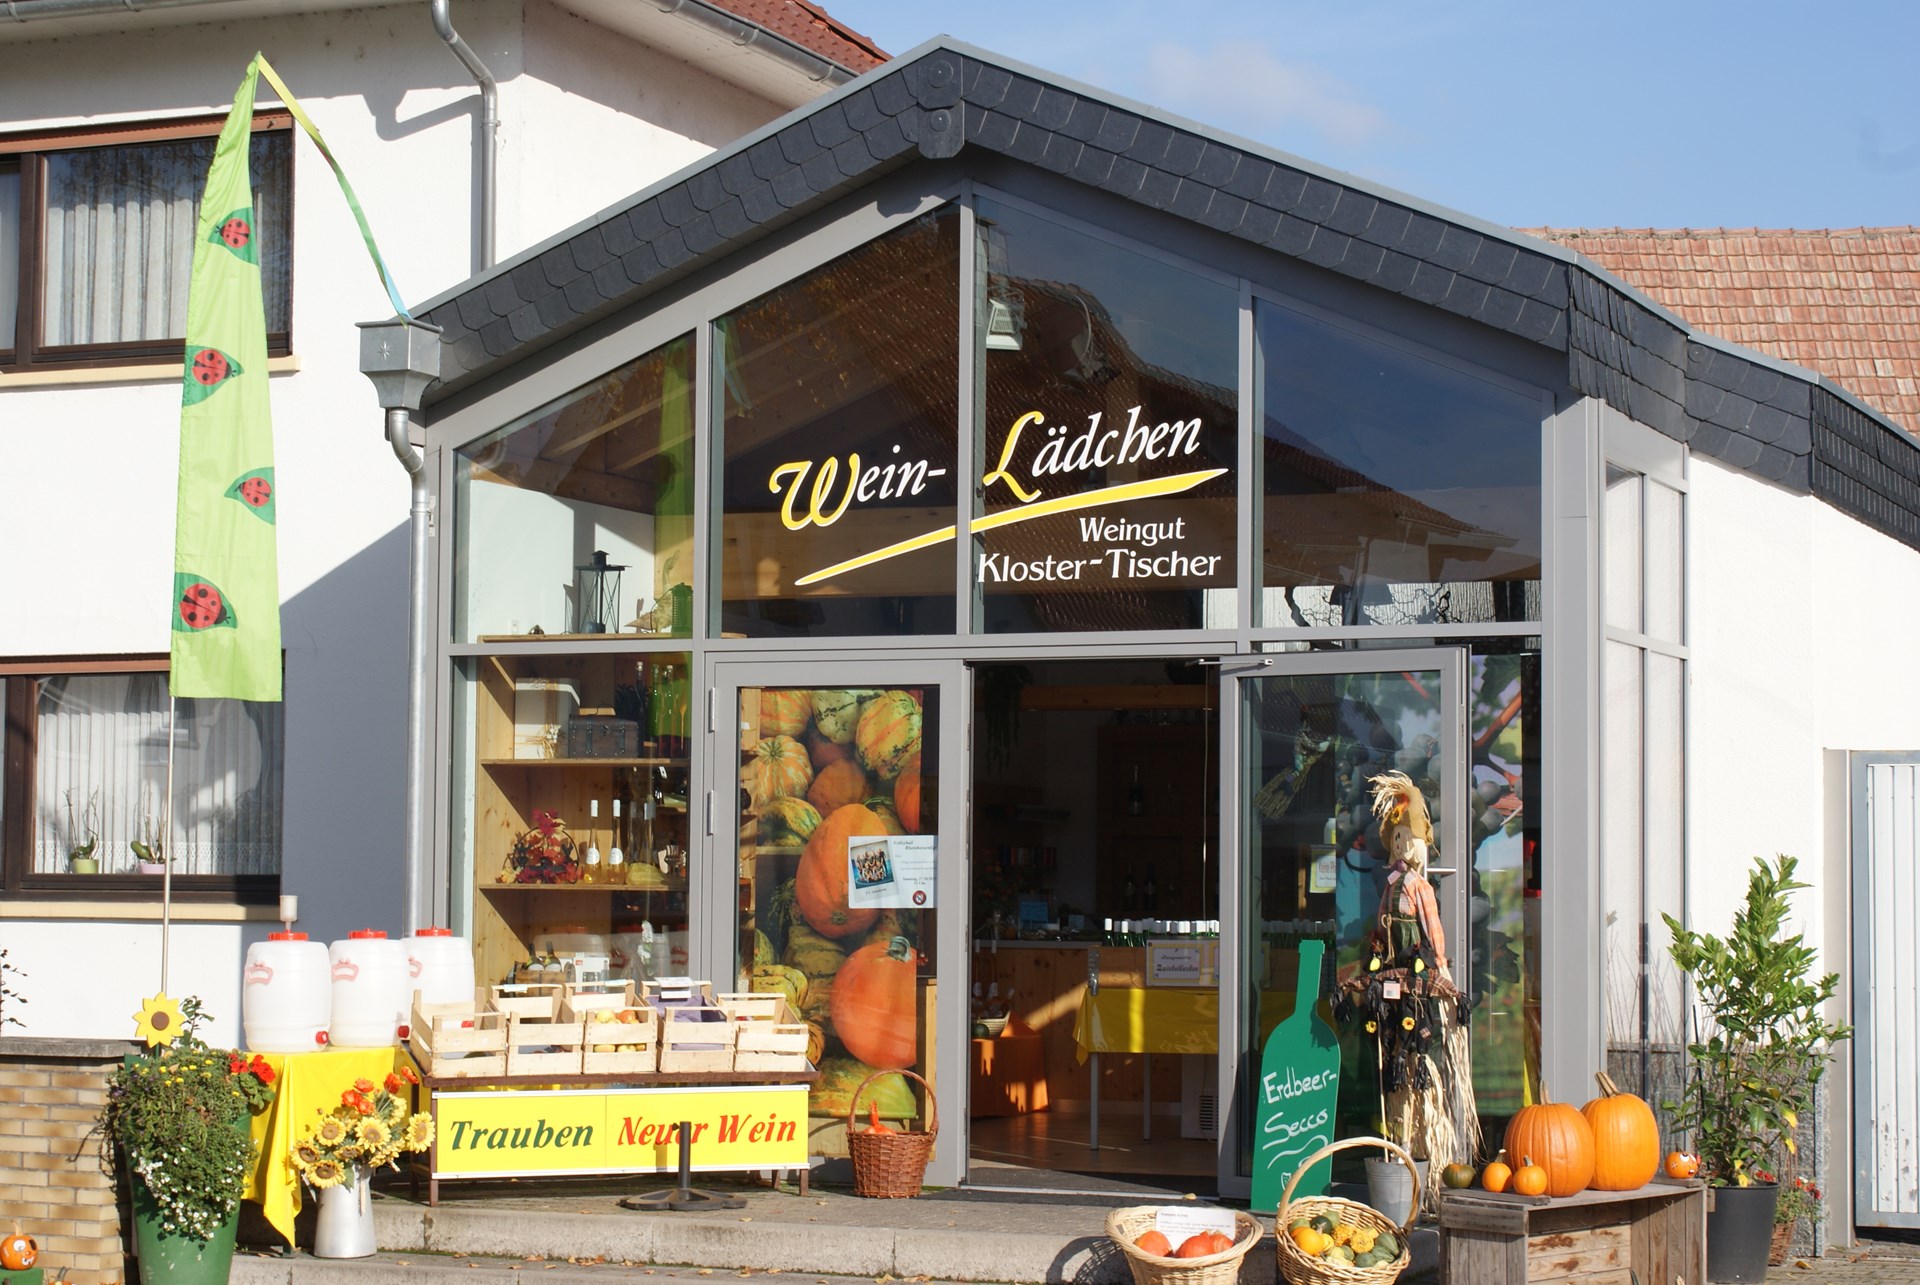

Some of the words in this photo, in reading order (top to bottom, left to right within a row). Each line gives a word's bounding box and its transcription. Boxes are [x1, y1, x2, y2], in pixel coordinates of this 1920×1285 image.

[769, 445, 947, 531] Wein-
[982, 405, 1203, 502] Lädchen
[1079, 516, 1186, 547] Weingut
[977, 548, 1222, 584] Kloster-Tischer
[1263, 1066, 1337, 1104] Erdbeer-
[450, 1119, 594, 1150] Trauben
[617, 1116, 709, 1146] Neur
[718, 1113, 797, 1143] Wein
[1262, 1109, 1329, 1150] Secco
